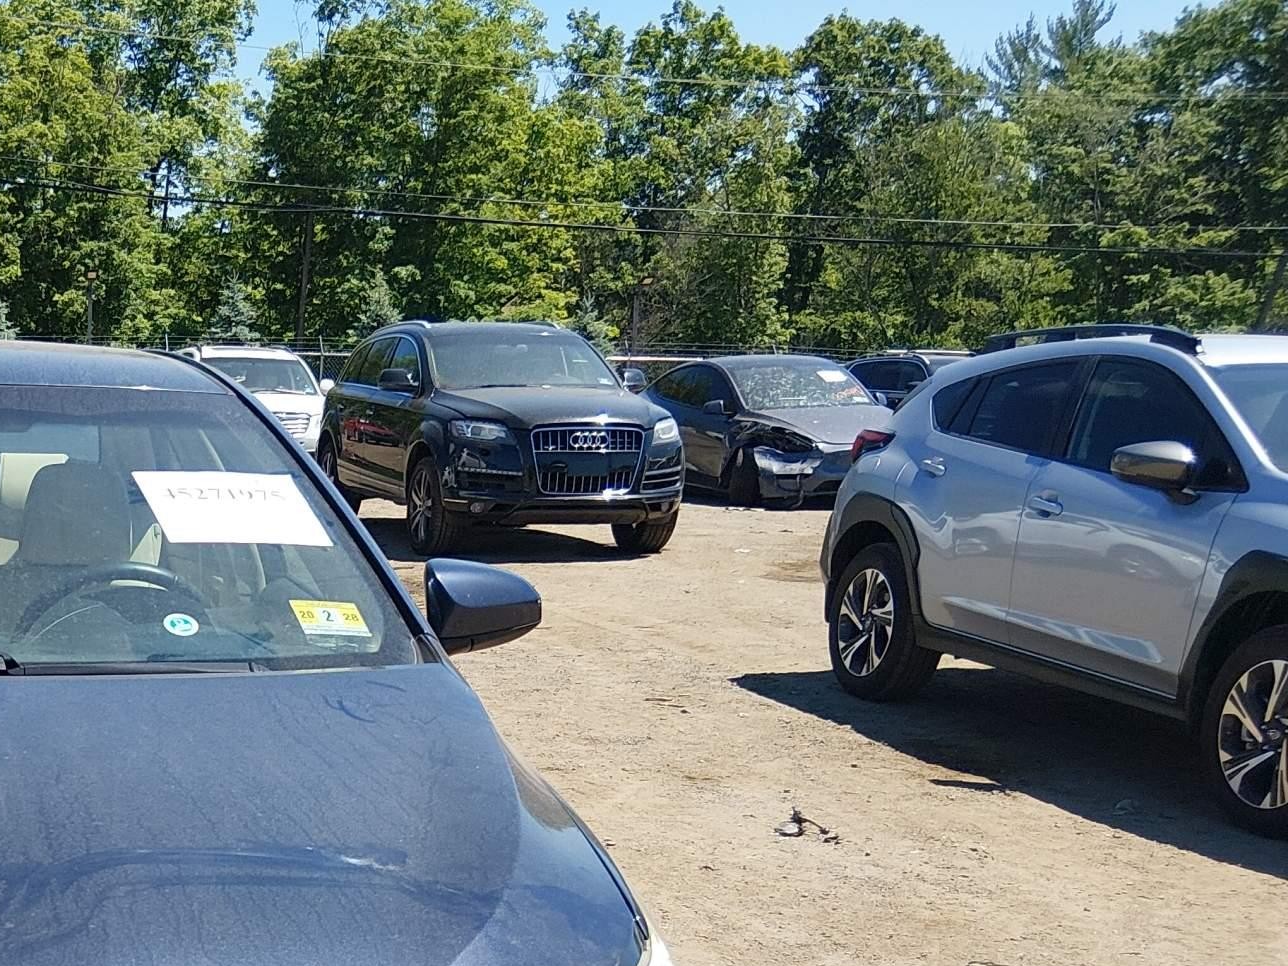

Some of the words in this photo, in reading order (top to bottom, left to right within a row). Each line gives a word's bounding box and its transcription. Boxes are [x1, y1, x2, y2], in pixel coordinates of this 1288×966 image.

[299, 610, 315, 619] 20
[322, 609, 335, 622] 2
[342, 612, 360, 622] 28
